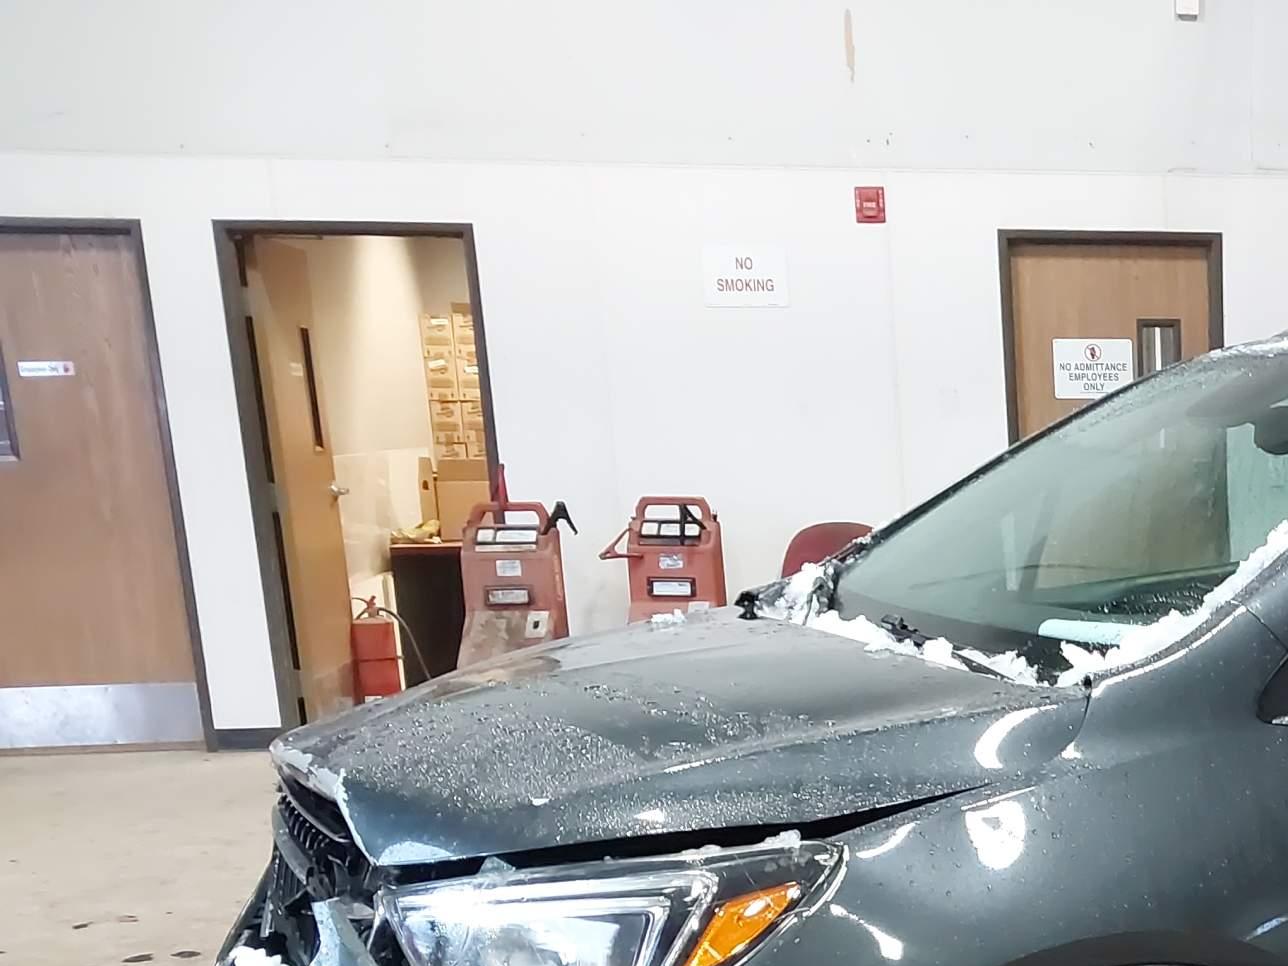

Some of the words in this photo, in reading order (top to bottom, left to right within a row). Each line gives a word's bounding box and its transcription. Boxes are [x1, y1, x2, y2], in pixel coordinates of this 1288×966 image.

[735, 256, 753, 270] NO
[716, 278, 775, 292] SMOKING
[1060, 362, 1072, 371] NO
[1074, 362, 1128, 371] ADMITTANCE
[1068, 372, 1120, 381] EMPLOYEES
[1083, 382, 1105, 391] ONLY
